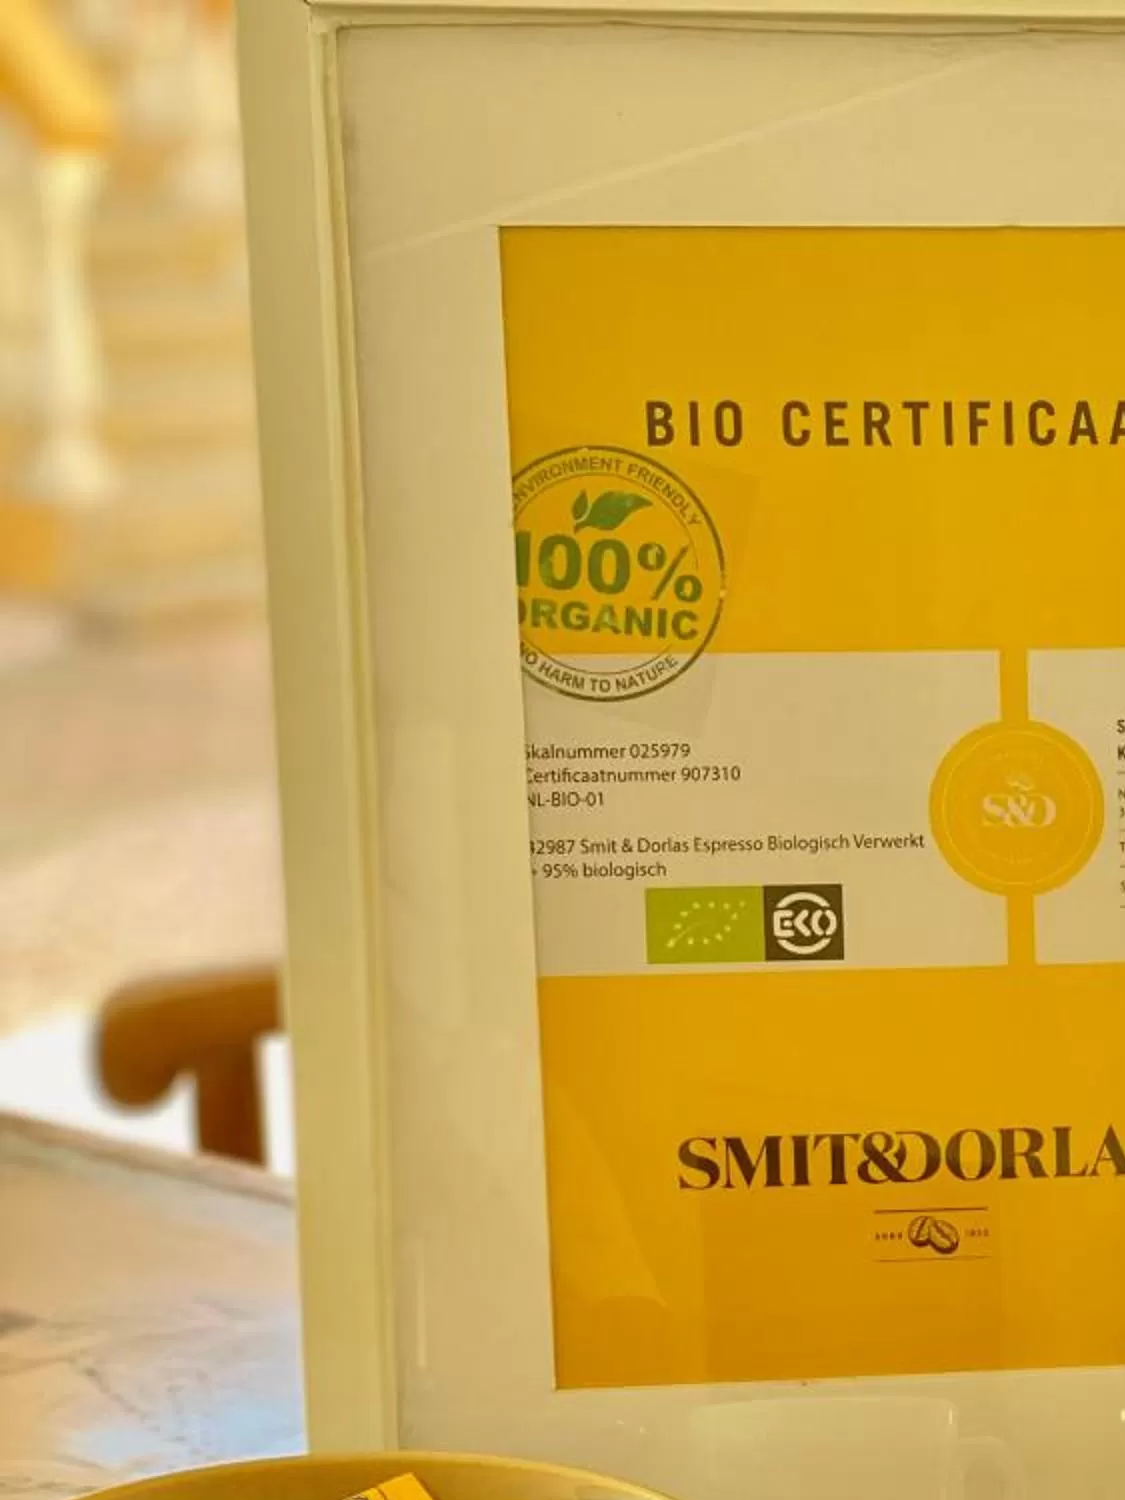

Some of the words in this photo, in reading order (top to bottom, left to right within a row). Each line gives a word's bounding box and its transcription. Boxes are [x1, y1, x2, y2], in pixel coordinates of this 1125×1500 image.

[645, 400, 744, 447] BIO
[627, 460, 702, 526] FRIENDLY
[515, 530, 704, 604] 100%
[538, 663, 585, 690] HARM
[589, 679, 611, 693] TO
[615, 654, 679, 692] NATURE
[629, 743, 692, 760] 025979
[681, 765, 742, 782] 907310
[580, 838, 618, 855] Smit
[621, 839, 634, 854] &
[637, 836, 690, 854] Dorlas
[694, 836, 763, 855] Espresso
[767, 834, 850, 854] Biologisch
[853, 832, 926, 849] Verwerkt
[543, 862, 579, 879] 95%
[582, 861, 668, 880] biologisch
[773, 908, 838, 938] EKO
